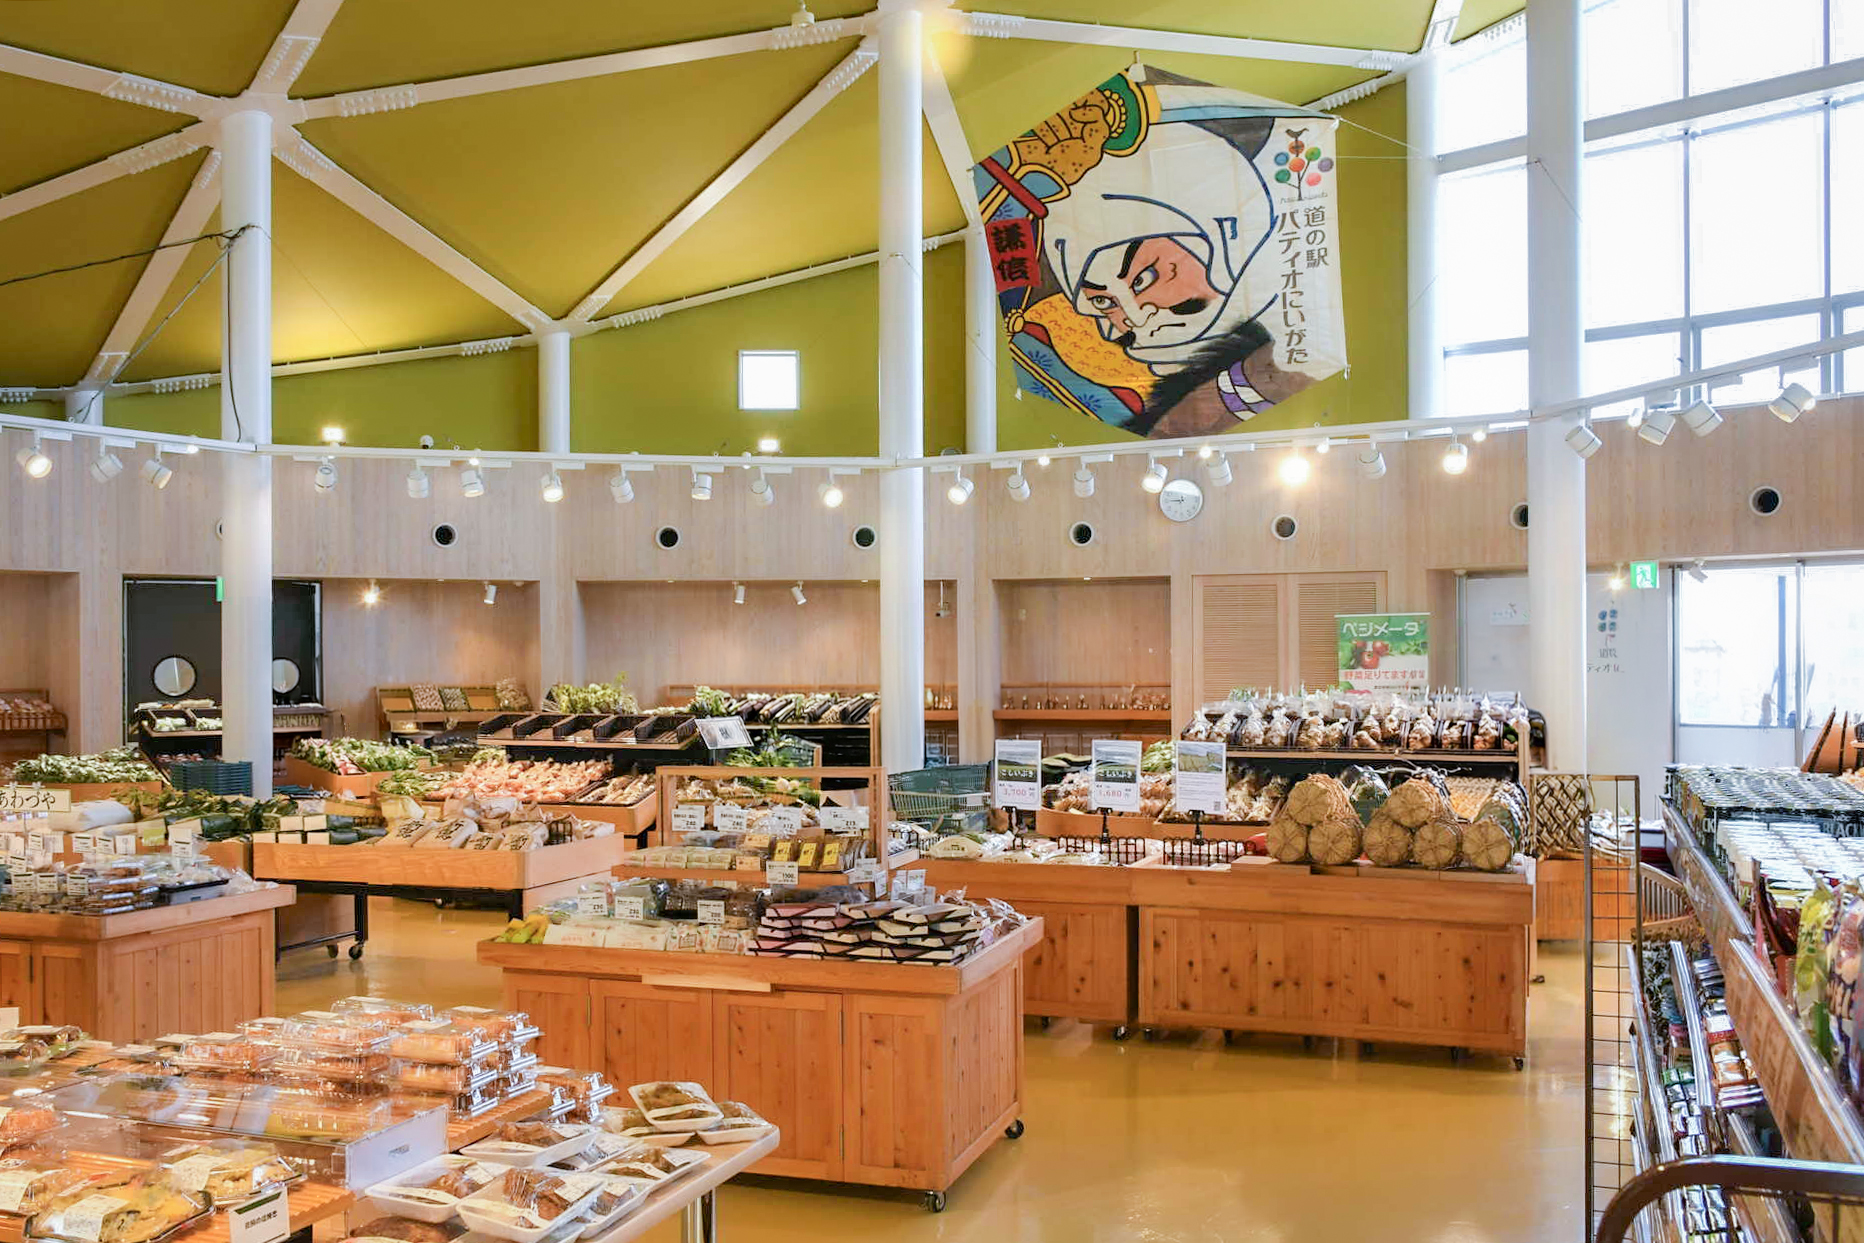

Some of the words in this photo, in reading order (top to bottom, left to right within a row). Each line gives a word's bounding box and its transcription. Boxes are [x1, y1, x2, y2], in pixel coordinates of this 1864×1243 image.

[1304, 206, 1329, 268] 道の駅
[1278, 209, 1309, 365] パティオにいがた
[1343, 621, 1420, 637] ベジメータ
